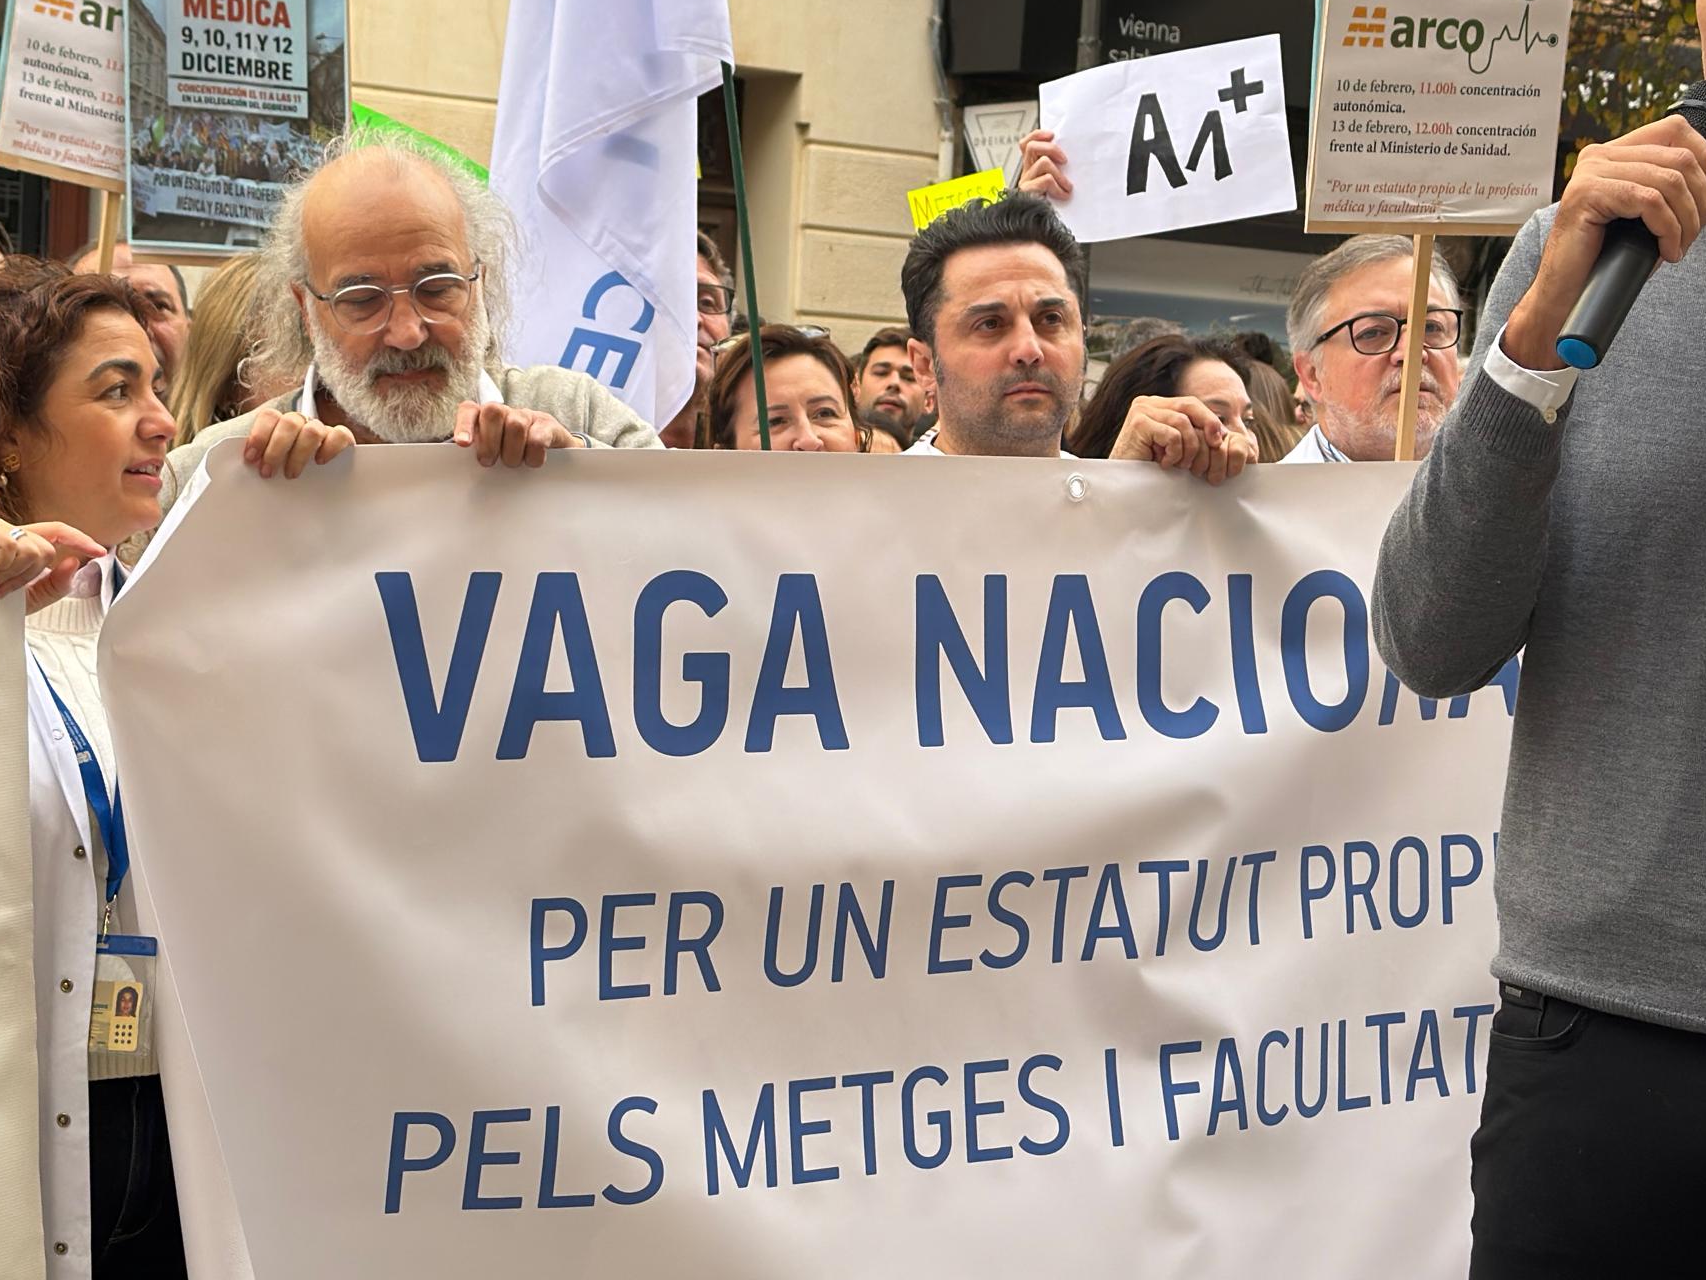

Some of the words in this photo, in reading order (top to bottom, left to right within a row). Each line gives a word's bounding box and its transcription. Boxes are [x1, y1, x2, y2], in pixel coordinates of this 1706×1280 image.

[1119, 14, 1181, 43] vienna
[1342, 6, 1485, 53] Marco
[42, 41, 56, 55] de
[182, 26, 199, 48] 9,
[204, 29, 231, 51] 10,
[235, 32, 251, 50] 11
[255, 35, 269, 52] Y
[272, 36, 293, 54] 12
[182, 52, 293, 81] DICIEMBRE
[37, 74, 51, 88] de
[1336, 79, 1350, 92] 10
[1353, 79, 1367, 93] de
[1370, 79, 1416, 97] febrero,
[1420, 81, 1457, 95] 11.00h
[1460, 83, 1541, 98] concentración
[19, 87, 53, 105] frente
[54, 97, 65, 108] al
[1333, 99, 1406, 114] autonómica.
[1332, 120, 1345, 133] 13
[1348, 119, 1363, 133] de
[1365, 119, 1412, 137] febrero,
[1415, 121, 1453, 135] 12.00h
[1456, 123, 1537, 138] concentración
[1329, 139, 1364, 154] frente
[1366, 140, 1377, 153] al
[1380, 141, 1441, 155] Ministerio
[1443, 141, 1458, 156] de
[1461, 142, 1511, 157] Sanidad.
[1355, 182, 1370, 193] un
[1373, 181, 1416, 194] estatuto
[1418, 181, 1456, 198] propio
[1458, 181, 1472, 195] de
[1475, 181, 1485, 195] la
[1487, 181, 1538, 199] profesión
[1323, 199, 1365, 213] médica
[1367, 203, 1375, 217] y
[374, 569, 850, 764] VAGA
[915, 568, 1523, 747] NACIO
[529, 891, 726, 1008] PER
[764, 880, 894, 988] UN
[926, 850, 1276, 976] ESTATUT
[1299, 832, 1500, 942] PROP
[383, 1097, 666, 1215] PELS
[702, 1054, 1071, 1197] METGES
[1104, 1048, 1127, 1147] I
